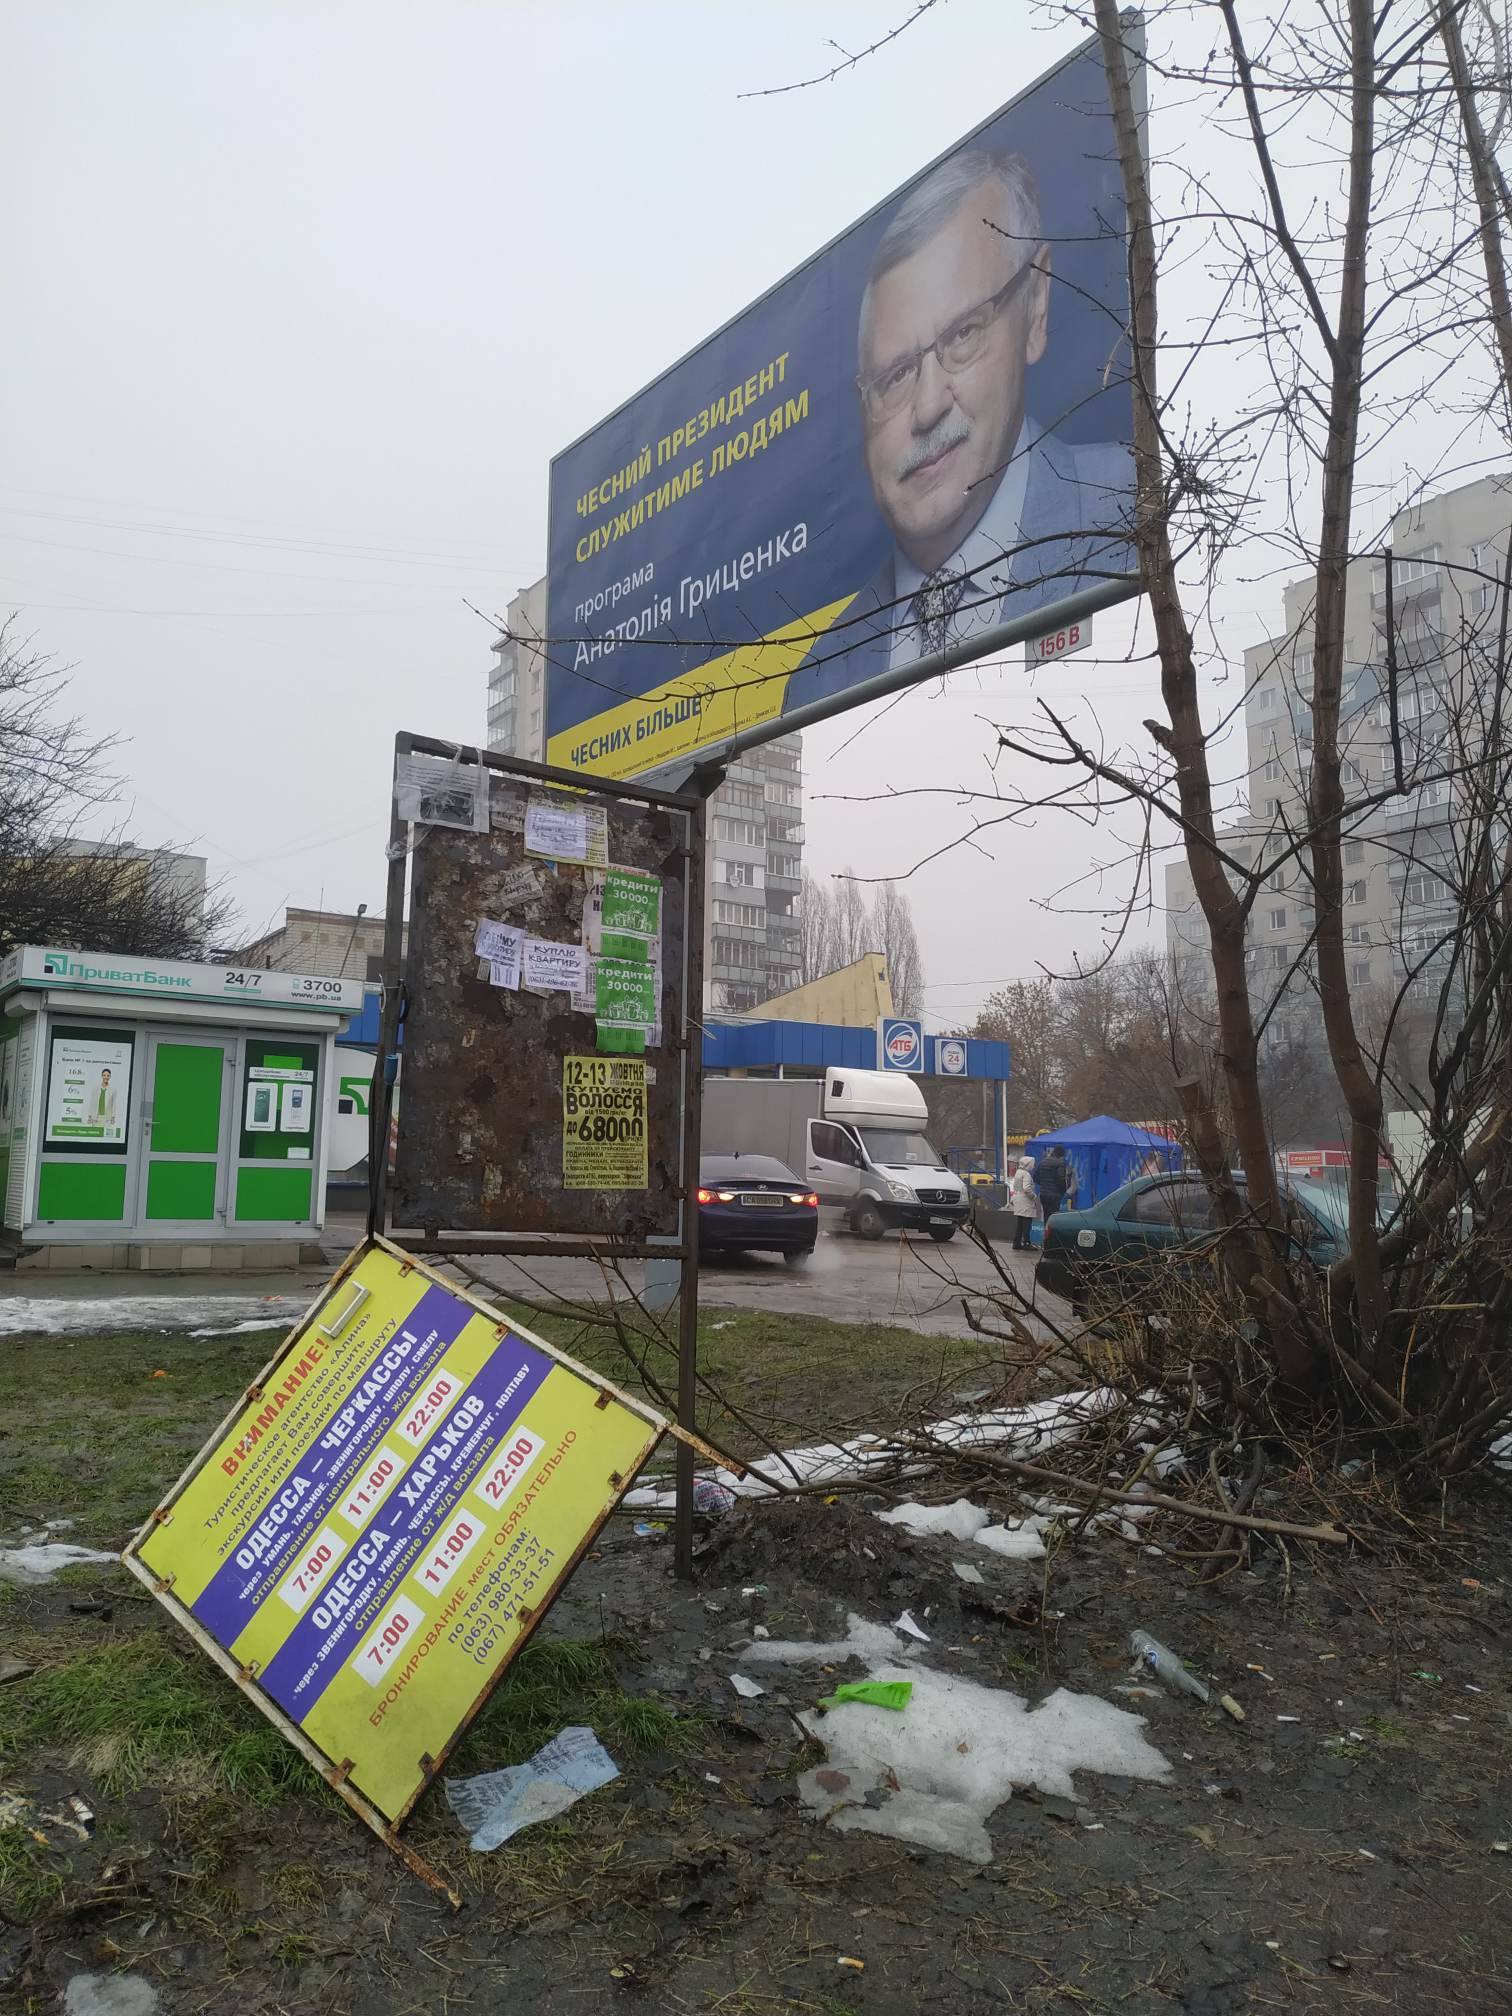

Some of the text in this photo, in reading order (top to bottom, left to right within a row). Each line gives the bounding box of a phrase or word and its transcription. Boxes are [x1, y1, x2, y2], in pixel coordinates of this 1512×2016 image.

[574, 389, 809, 564] СЛУЖИТИМЕ ЛЮДЯМ
[576, 351, 789, 519] ЧЕСНИЙ ПРЕЗИДЕНТ
[574, 561, 655, 624] програма
[574, 522, 808, 671] Анатолія Гриценка
[1039, 631, 1065, 657] 156
[571, 723, 632, 767] ЧЕСНИХ
[636, 692, 703, 738] БІЛЬШЕ
[607, 876, 658, 893] кредити
[69, 963, 342, 993] ПриватБанк 24/7 3700
[291, 991, 342, 1001] www.pb.ua
[528, 954, 581, 968] КВАРТИРУ
[534, 945, 576, 957] КУПЛЮ
[597, 967, 653, 981] кредити
[566, 1061, 644, 1085] 12-13 ЖОВТНЯ
[566, 1085, 642, 1094] КУПУЄМО
[890, 1039, 912, 1051] АТБ
[947, 1055, 960, 1063] 24
[566, 1093, 643, 1117] ВОЛОССЯ
[579, 1116, 643, 1142] 68000
[204, 1312, 372, 1530] Туристическое агентство «Алина»
[217, 1318, 397, 1556] экскурсии или поездки по маршруту
[221, 1337, 330, 1477] ВНИМАНИЕ!
[231, 1339, 366, 1517] предлагает Вам совершить
[235, 1476, 312, 1570] ОДЕССА
[320, 1331, 419, 1450] ЧЕРКАССЫ
[239, 1570, 263, 1600] через
[292, 1481, 329, 1526] ТАЛЬНОЕ,
[327, 1403, 386, 1479] ЗВЕНИГОРОДКУ,
[412, 1329, 438, 1362] СМЕЛУ
[251, 1341, 448, 1606] отправление от центрального ж/д вокзала
[292, 1379, 452, 1593] 7:00 11:00 22:00
[294, 1663, 319, 1694] через
[317, 1576, 382, 1662] ЗВЕНИГОРОДКУ,
[378, 1535, 412, 1573] УМАНЬ,
[408, 1475, 455, 1530] ЧЕРКАССЫ,
[496, 1364, 529, 1409] ПОЛТАВУ
[312, 1529, 391, 1630] ОДЕССА
[398, 1395, 486, 1507] ХАРЬКОВ
[355, 1435, 495, 1631] отправление от ж/д вокзала
[368, 1437, 533, 1667] 7:00 11:00 22:00
[368, 1587, 469, 1728] БРОНИРОВАНИЕ
[466, 1550, 497, 1587] мест
[494, 1429, 577, 1546] ОБЯЗАТЕЛЬНО
[447, 1527, 532, 1644] по телефонам:
[460, 1537, 541, 1653] (063) 980-33-37
[473, 1548, 556, 1665] (067) 471-51-51
